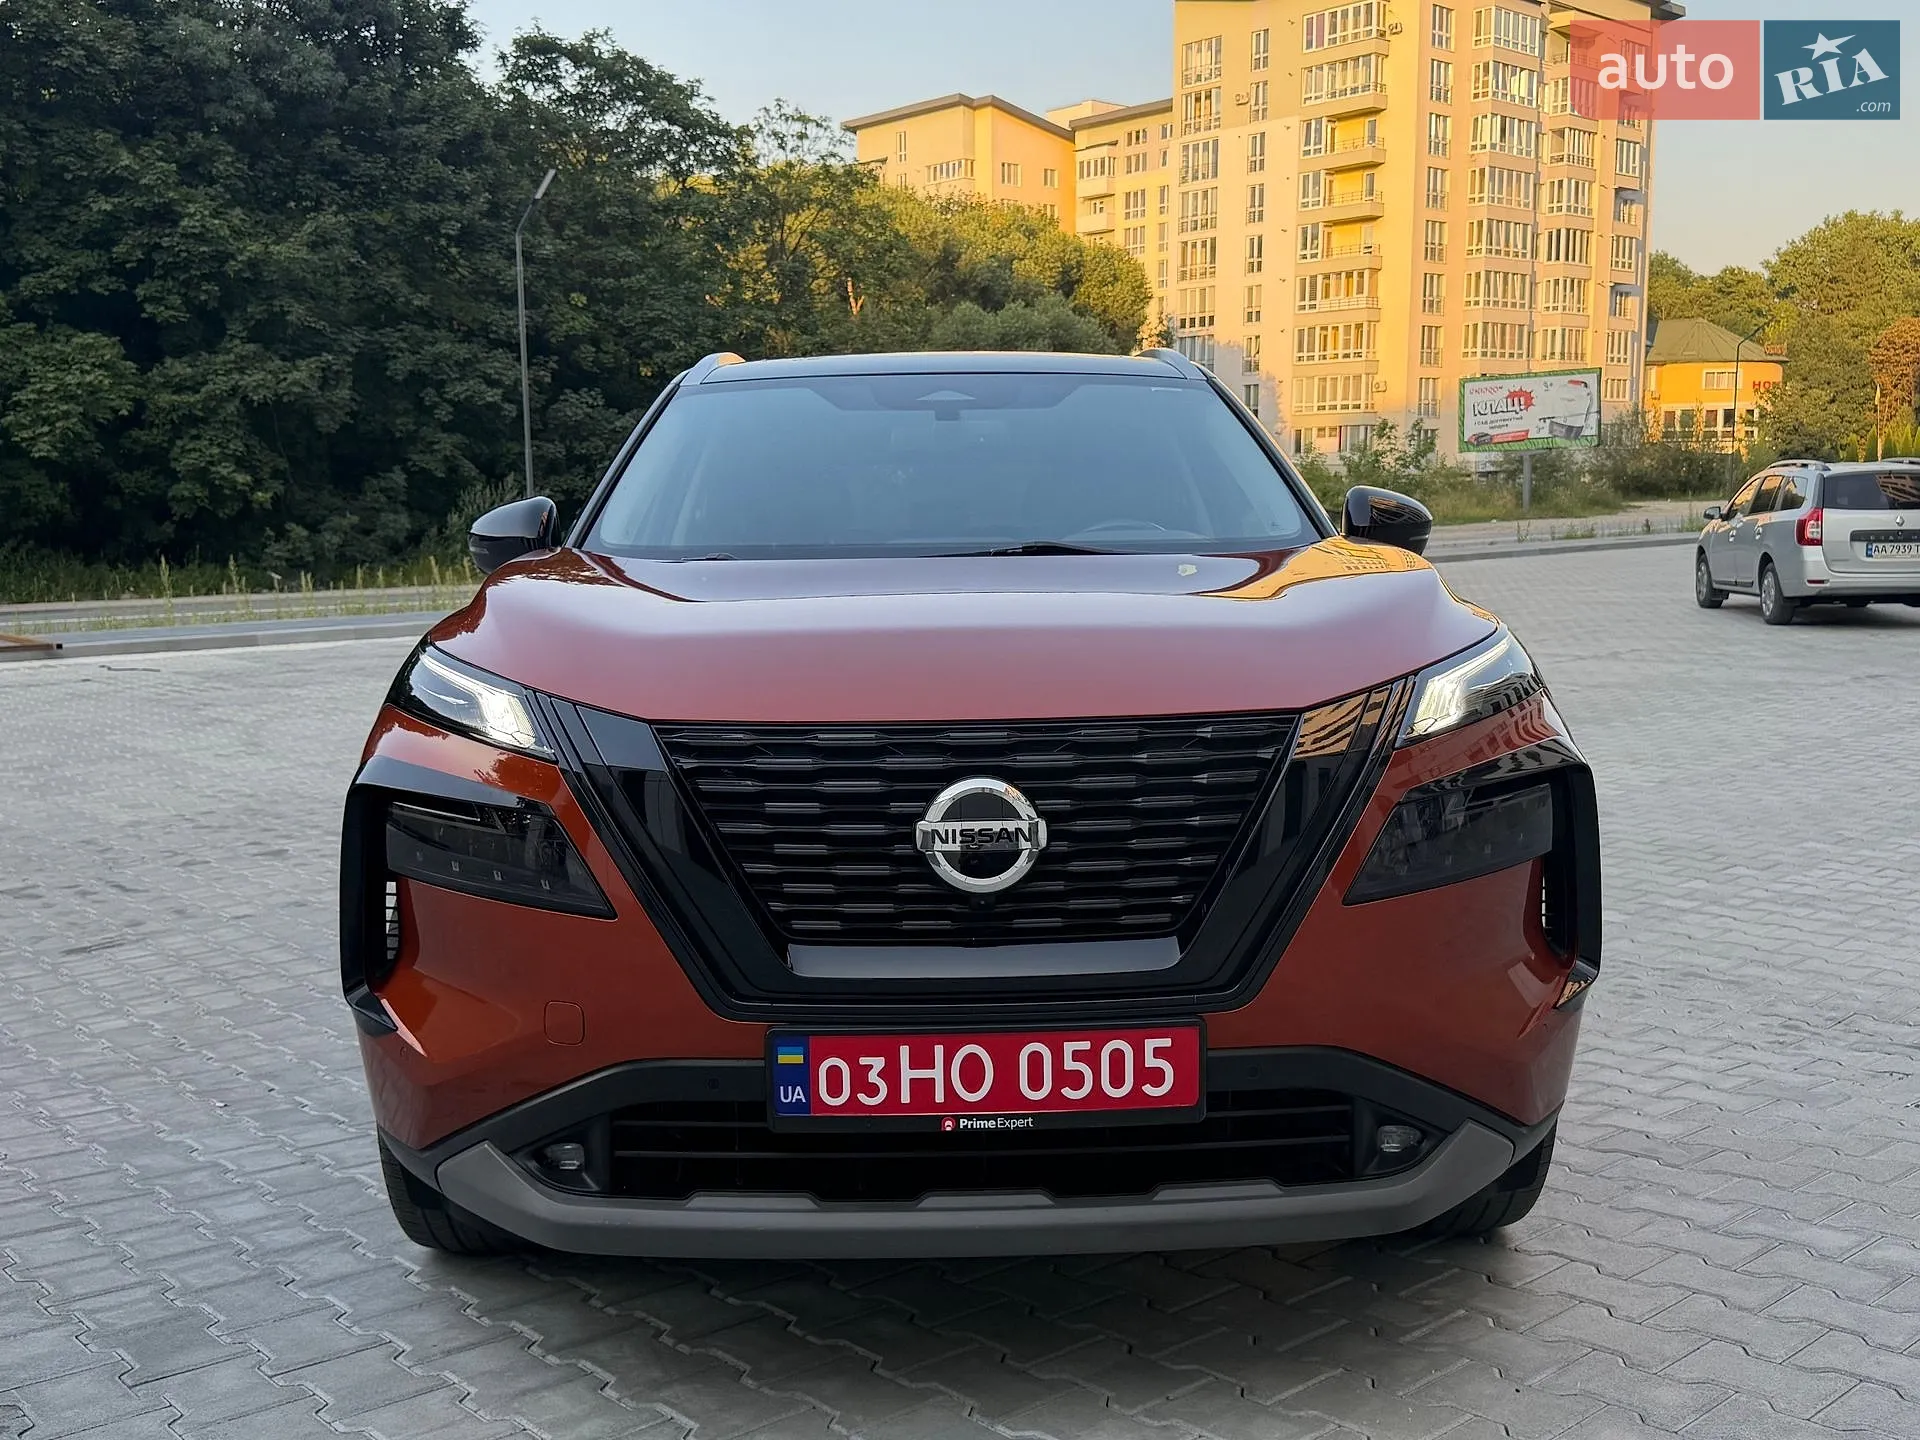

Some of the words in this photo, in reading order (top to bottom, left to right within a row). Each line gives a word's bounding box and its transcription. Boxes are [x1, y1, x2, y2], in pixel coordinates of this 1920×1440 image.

[931, 827, 1032, 845] NISSAN
[1018, 1037, 1175, 1101] 0505
[779, 1085, 806, 1104] UA
